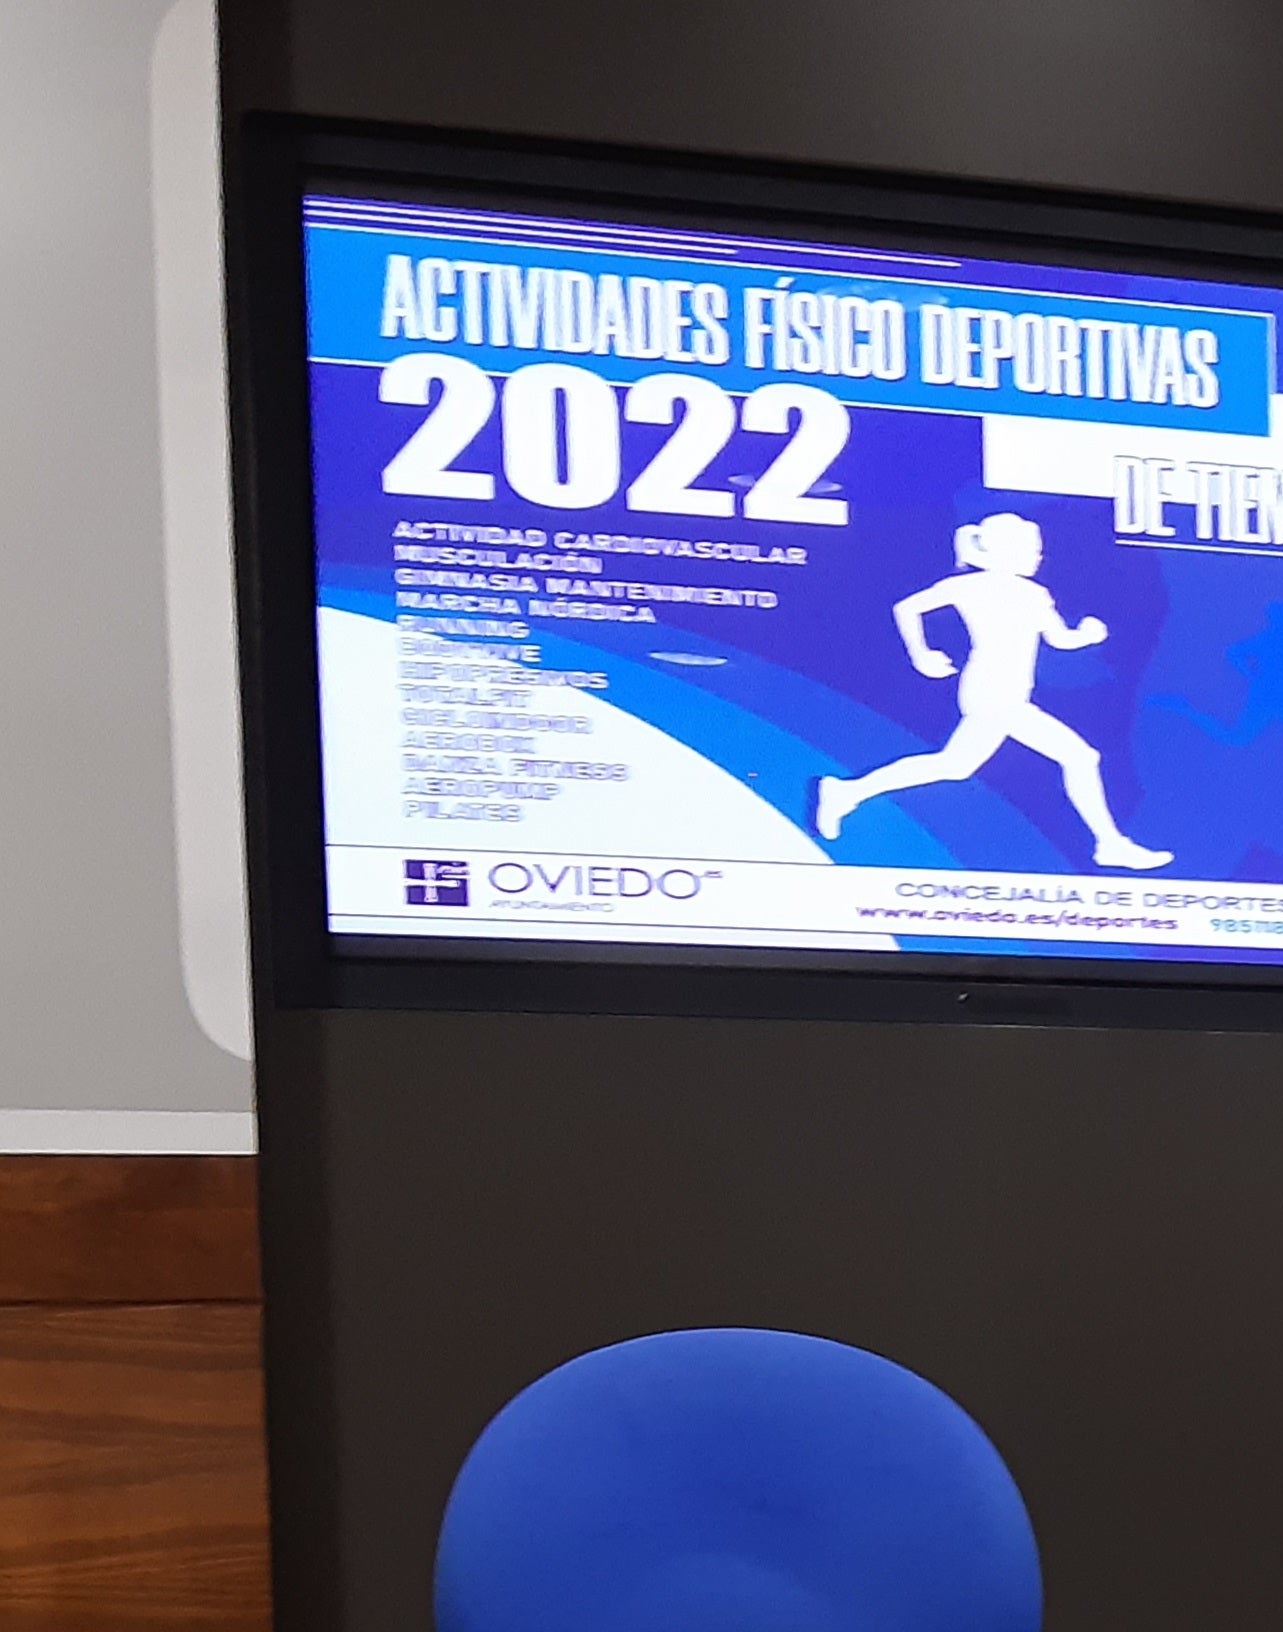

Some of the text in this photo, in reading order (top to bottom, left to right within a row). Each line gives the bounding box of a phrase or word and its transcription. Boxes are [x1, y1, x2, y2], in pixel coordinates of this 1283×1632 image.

[380, 253, 1220, 408] ACTIVIDADES FÍSICO DEPORTIVAS
[378, 352, 851, 526] 2022
[1114, 455, 1176, 537] DE
[392, 521, 808, 565] ACTIVIDAD CARDIOVASCULAR
[394, 544, 604, 574] MUSCULACIÓN
[395, 568, 778, 609] GIMNASIA MANTENIMIENTO
[396, 591, 656, 623] MARCHA NÓRDICA
[894, 881, 1086, 906] CONCEJALÍA
[1093, 890, 1134, 908] DE
[854, 905, 1179, 931] www.oviedo.es/deportes
